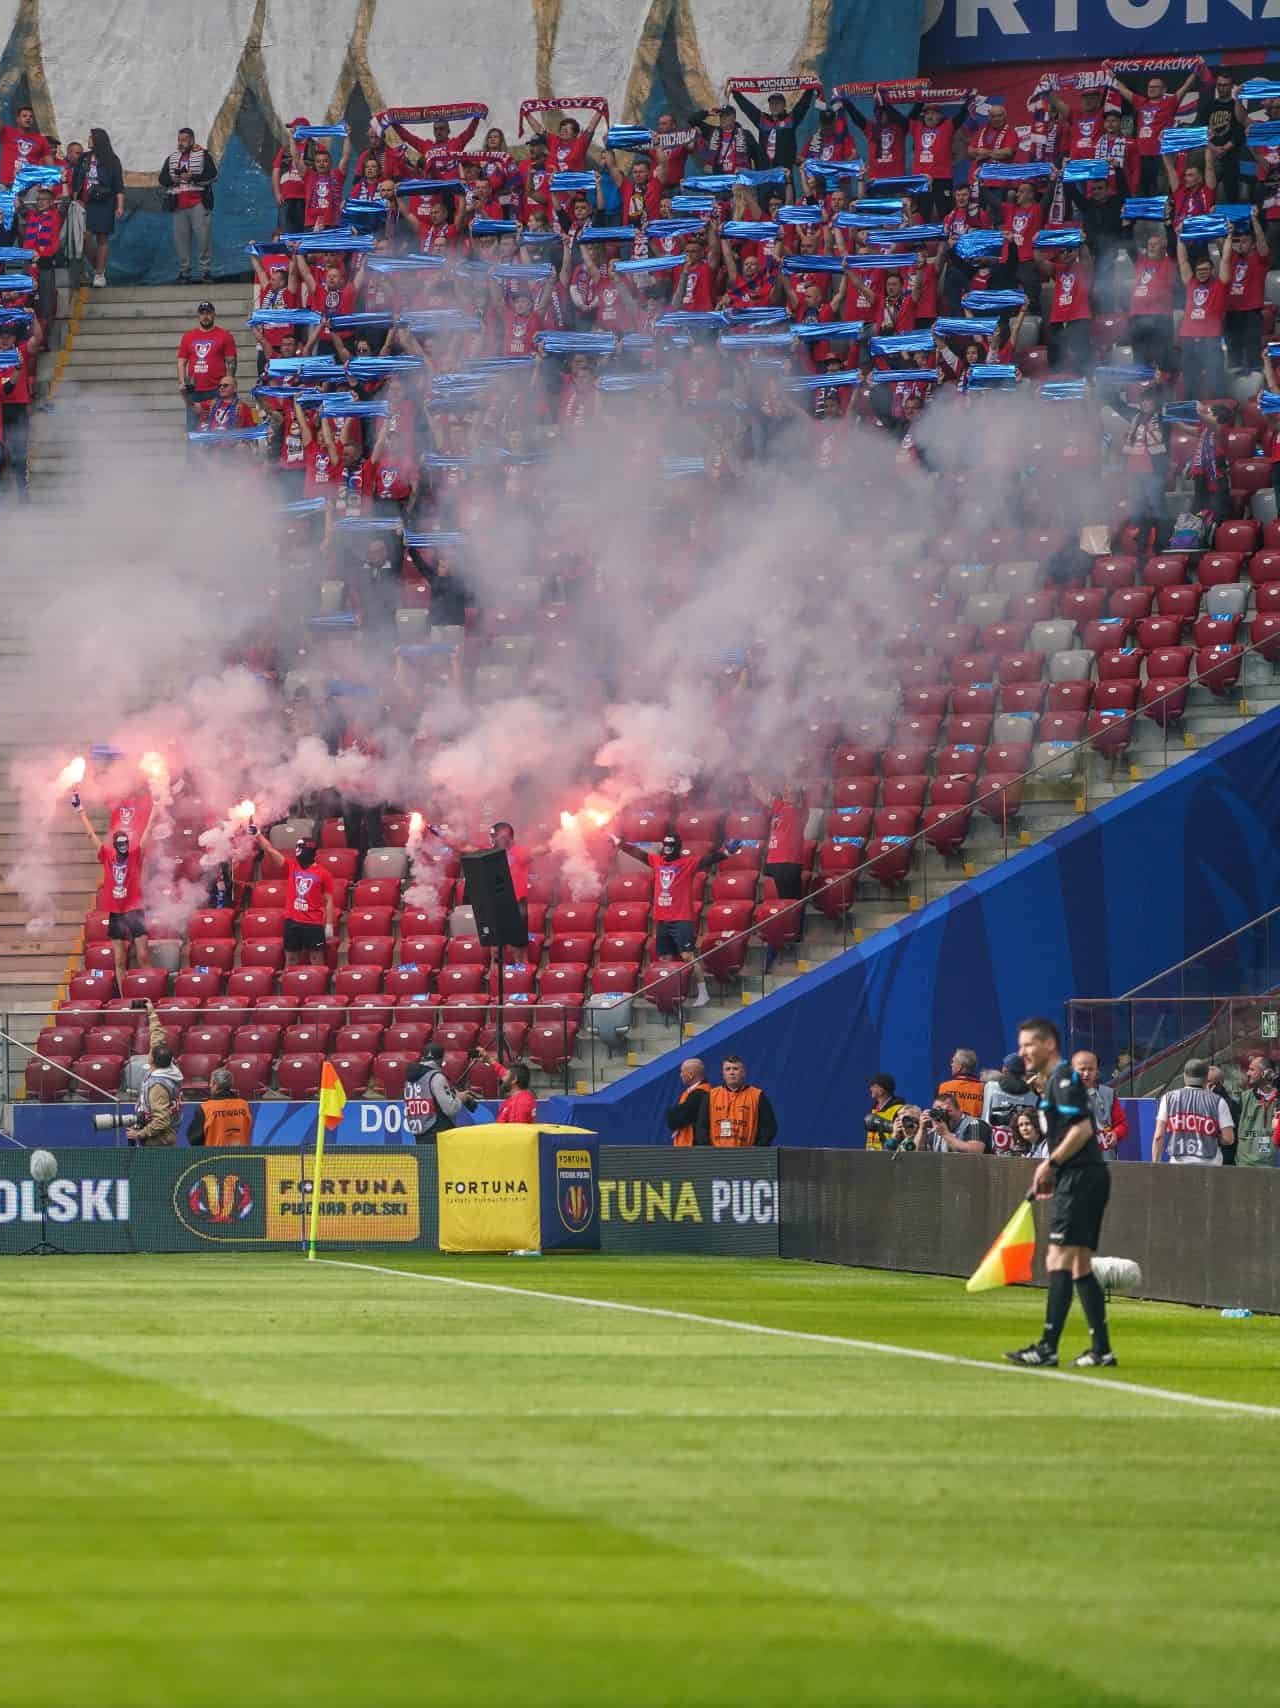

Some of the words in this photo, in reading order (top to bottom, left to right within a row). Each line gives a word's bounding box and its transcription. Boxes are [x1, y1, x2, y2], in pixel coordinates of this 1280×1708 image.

[280, 1179, 407, 1195] FORTUNA
[445, 1180, 528, 1195] FORTUNA
[599, 1180, 703, 1224] TUNA
[712, 1179, 779, 1225] PUC
